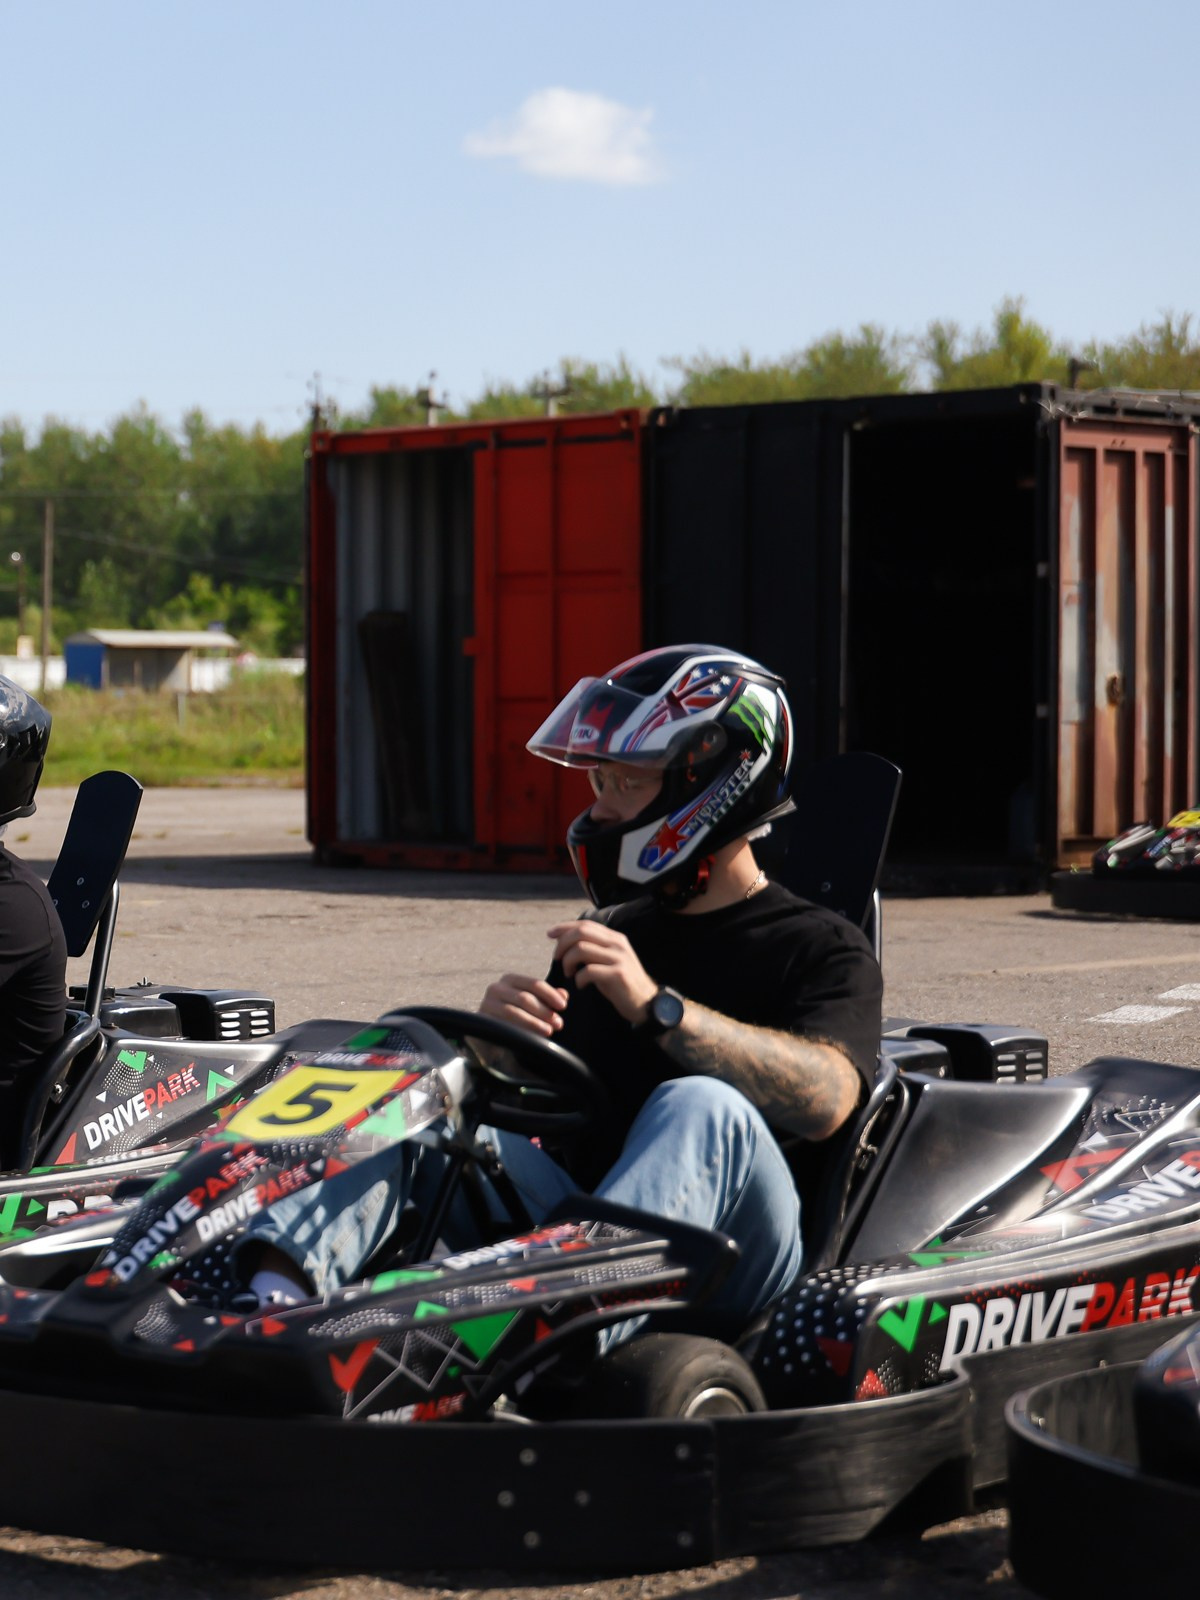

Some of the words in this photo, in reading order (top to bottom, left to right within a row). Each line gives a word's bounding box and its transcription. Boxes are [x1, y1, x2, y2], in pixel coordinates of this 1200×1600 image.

[83, 1062, 201, 1150] DRIVEPARK
[259, 1083, 357, 1125] 5
[113, 1149, 271, 1282] DRIVEPARK
[195, 1160, 314, 1242] DRIVEPARK
[939, 1265, 1199, 1372] DRIVEPARK
